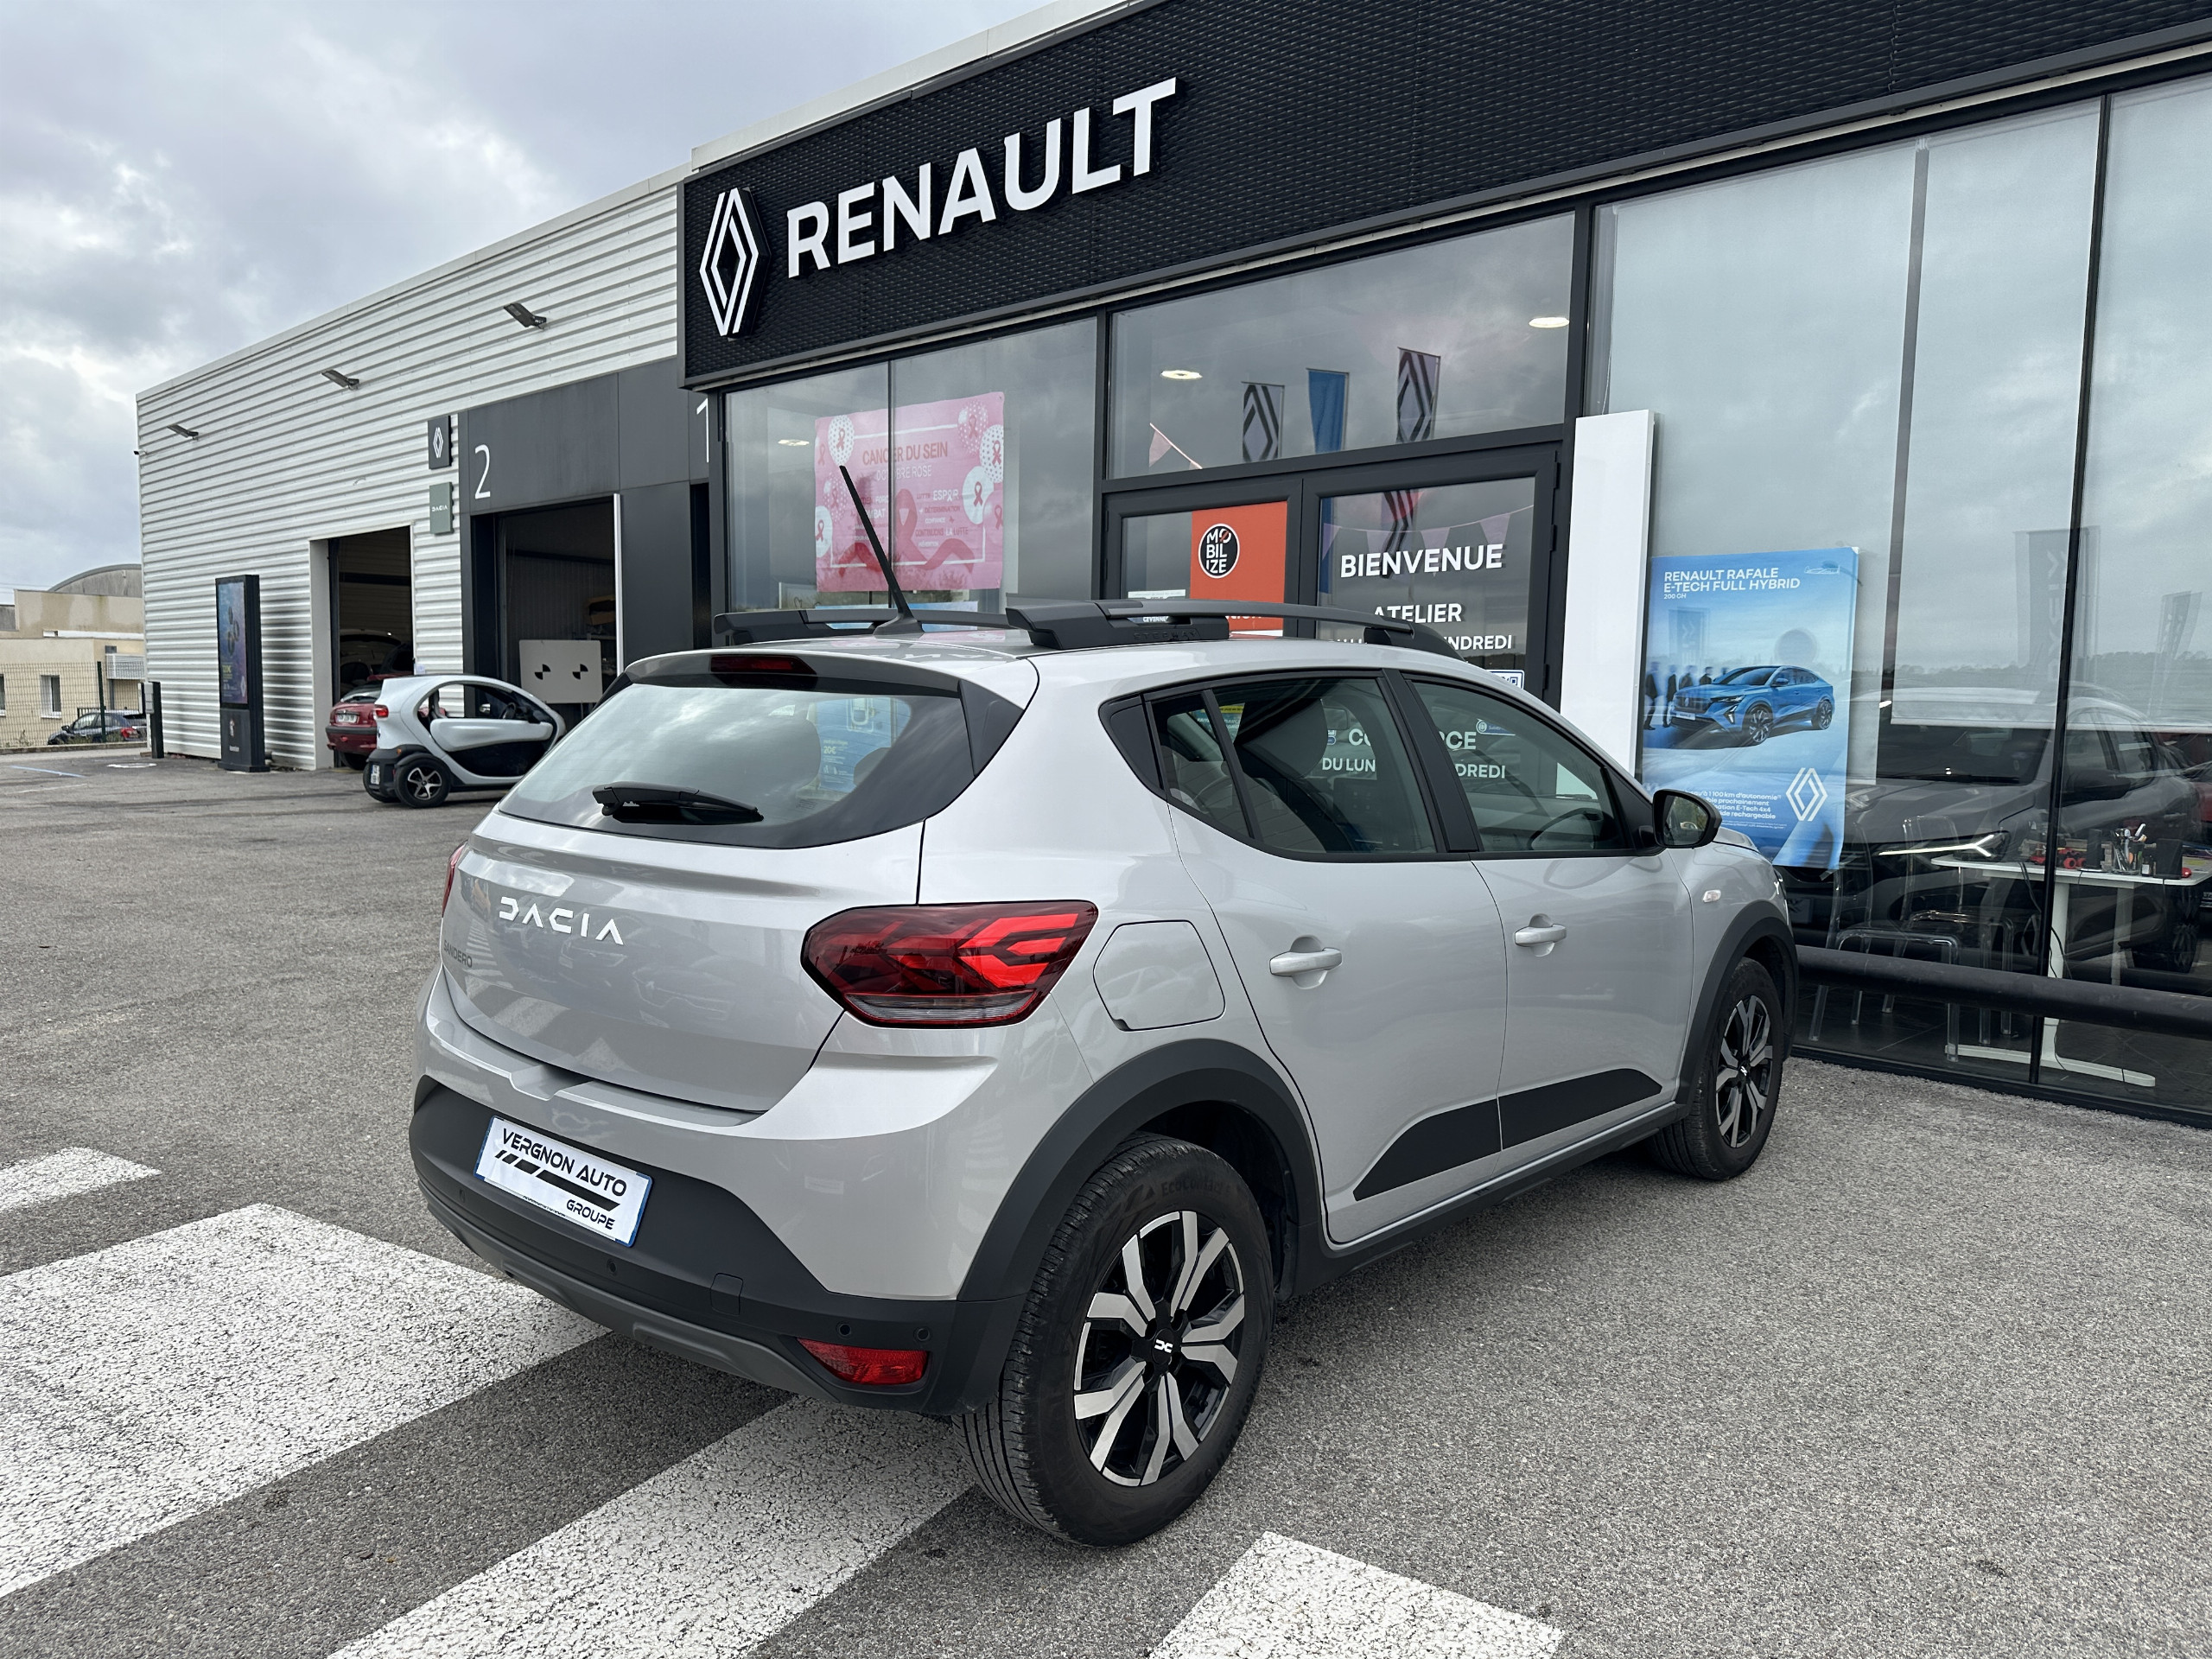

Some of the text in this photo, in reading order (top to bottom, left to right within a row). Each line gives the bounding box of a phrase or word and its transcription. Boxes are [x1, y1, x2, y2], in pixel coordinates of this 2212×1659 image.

[786, 77, 1176, 279] RENAULT
[906, 444, 921, 461] DU
[923, 441, 948, 460] SEIN
[474, 444, 492, 500] 2
[876, 464, 932, 481] OCBRE ROSE
[1206, 528, 1232, 544] MO
[1206, 543, 1227, 559] BIL
[1340, 543, 1503, 578] BIENVENUE
[1205, 558, 1227, 574] IZE
[1664, 567, 1779, 582] RENAULT RAFALE
[1663, 578, 1801, 593] E-TECH FULL HYBRID
[1374, 603, 1462, 623] ATELIER
[1444, 635, 1512, 651] NDREDI
[1322, 757, 1506, 779] DU LUN DREDI
[1731, 811, 1777, 820] rechargeable
[499, 895, 625, 946] DACIA
[443, 939, 474, 969] SANDERO
[502, 1127, 627, 1198] VERGNON AUTO
[566, 1198, 616, 1230] GROUPE
